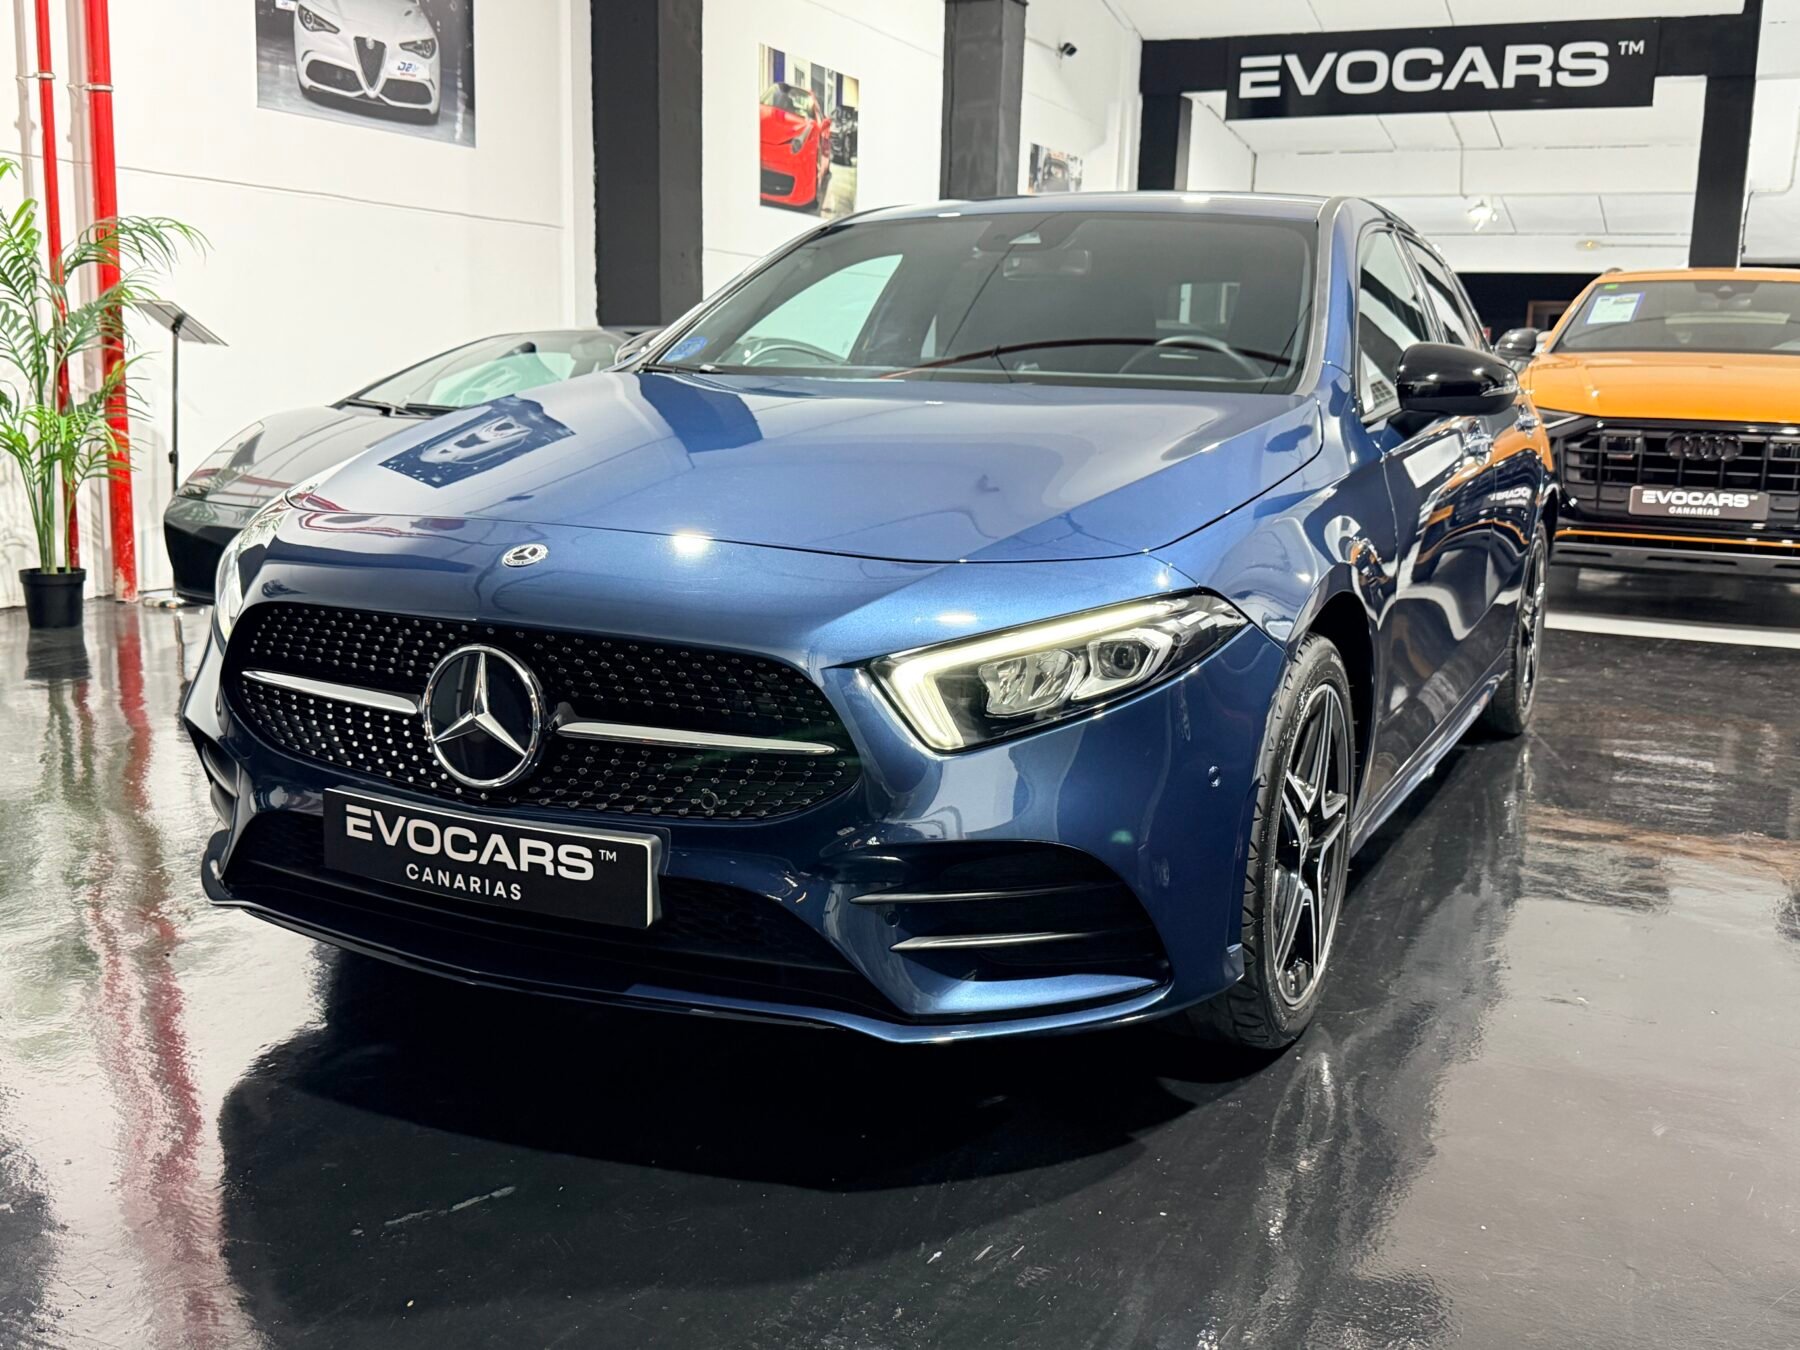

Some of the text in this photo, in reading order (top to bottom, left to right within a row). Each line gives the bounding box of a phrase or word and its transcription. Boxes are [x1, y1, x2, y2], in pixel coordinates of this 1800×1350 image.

[1238, 41, 1610, 99] EVOCARS
[1641, 490, 1750, 508] EVOCARS
[1668, 506, 1721, 516] CANARIAS
[345, 803, 595, 882] EVOCARS
[405, 862, 523, 901] CANARIAS
